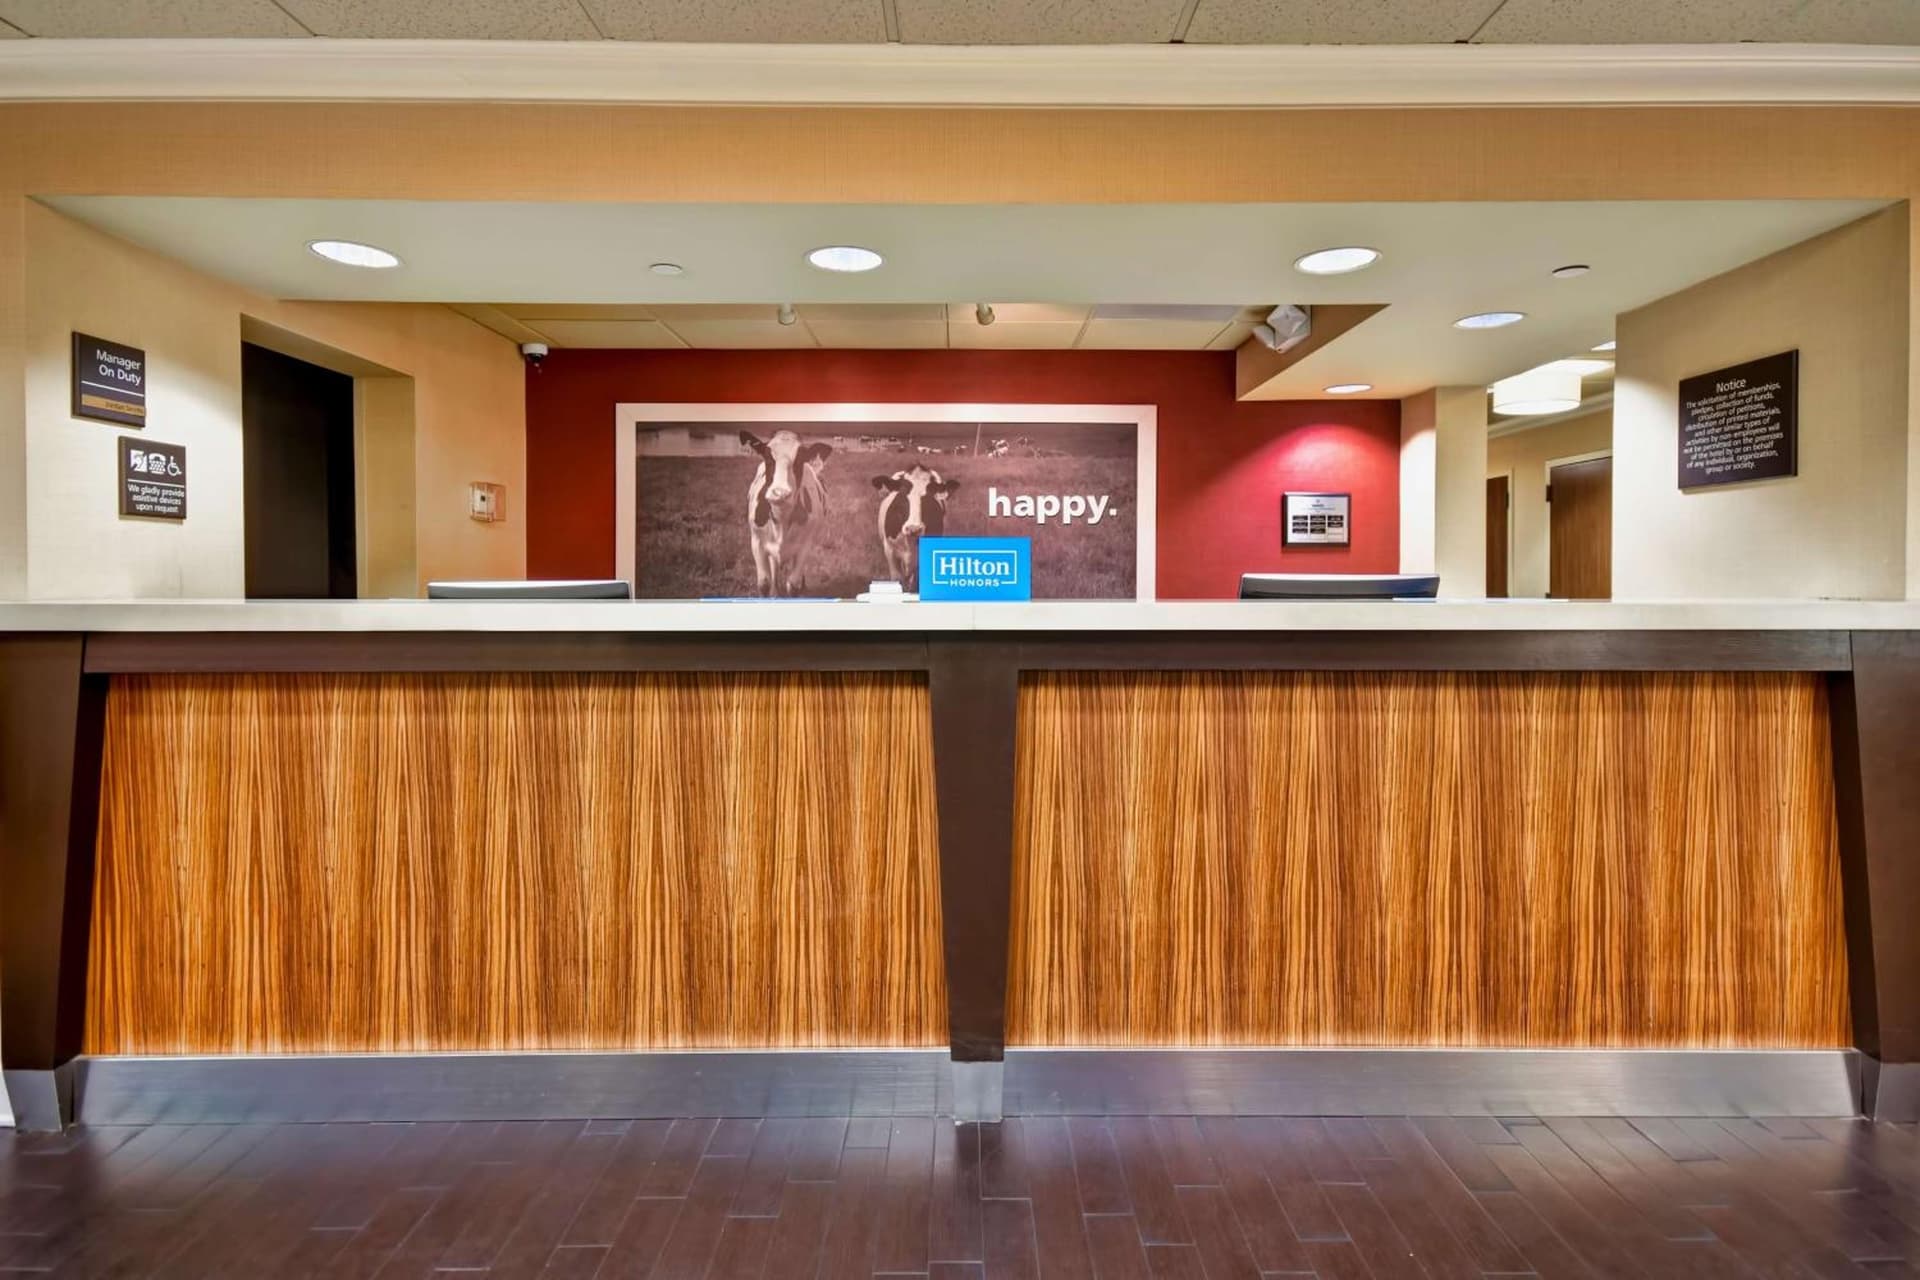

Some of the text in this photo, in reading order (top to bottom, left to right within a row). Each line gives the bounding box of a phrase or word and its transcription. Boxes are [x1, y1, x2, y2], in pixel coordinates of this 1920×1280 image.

[96, 349, 142, 371] Manager
[98, 364, 142, 386] On Duty
[1716, 379, 1747, 393] Notice
[1698, 394, 1728, 406] solicitation
[1716, 399, 1745, 410] collection
[1745, 395, 1753, 403] of
[1698, 410, 1728, 421] circulation
[1728, 407, 1736, 415] of
[1685, 420, 1717, 432] distribution
[1718, 417, 1726, 425] of
[1726, 414, 1749, 426] printed
[1694, 416, 1770, 438] and other similar types of
[1685, 436, 1710, 446] activities
[1710, 435, 1719, 443] by
[1768, 422, 1780, 431] will
[1702, 440, 1732, 452] permitted
[1754, 432, 1784, 443] premises
[1690, 452, 1698, 460] of
[1709, 448, 1725, 457] hotel
[1725, 448, 1734, 456] by
[1752, 440, 1774, 450] behalf
[1686, 461, 1694, 469] of
[1694, 460, 1705, 468] any
[1705, 465, 1724, 475] group
[127, 484, 185, 498] We gladly provide
[132, 494, 182, 505] assistive devices
[988, 487, 1118, 525] happy.
[135, 504, 153, 512] upon
[939, 557, 1010, 576] Hilton
[950, 579, 1000, 588] HONORS
